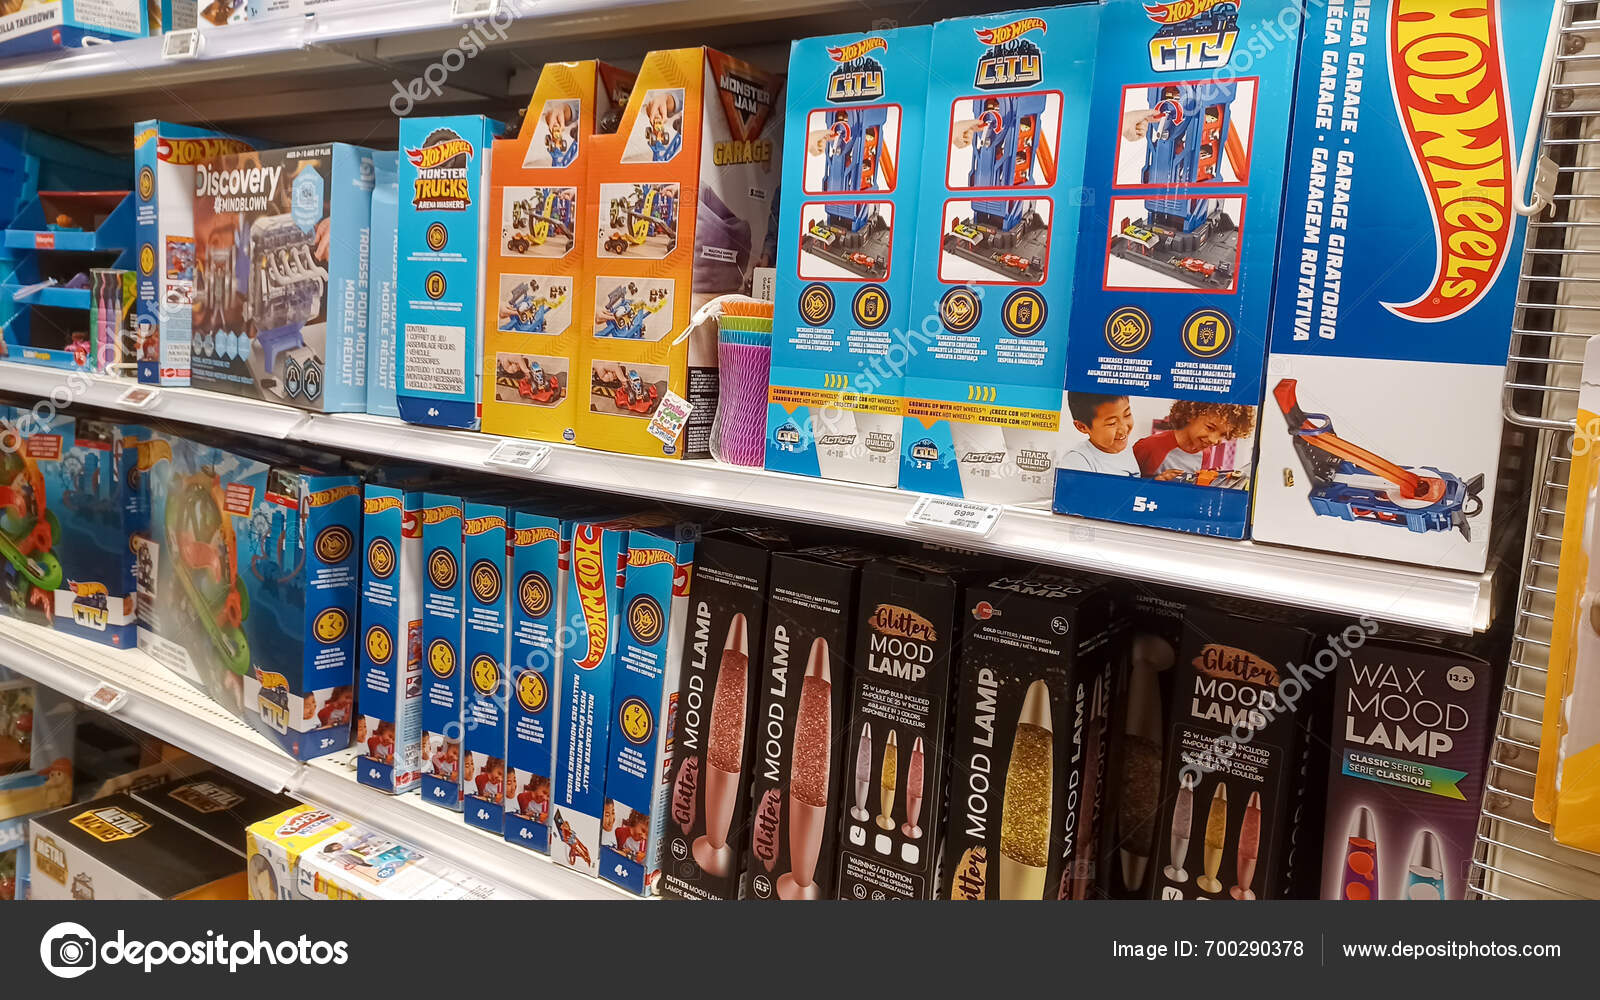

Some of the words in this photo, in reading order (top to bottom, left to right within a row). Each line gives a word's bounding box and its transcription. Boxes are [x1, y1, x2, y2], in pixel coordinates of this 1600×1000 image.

[16, 11, 56, 28] TAKEDOWN
[991, 24, 1012, 45] HOT
[1010, 17, 1046, 38] WHEELS
[1166, 2, 1193, 23] HOT
[840, 43, 860, 62] HOT
[857, 37, 887, 56] WHEELS
[1397, 0, 1491, 104] HOT
[719, 75, 770, 105] MONSTER
[734, 97, 758, 115] JAM
[1315, 50, 1339, 130] GARAGE
[1341, 52, 1365, 133] GARAGE
[422, 148, 441, 167] HOT
[439, 141, 472, 161] WHEELS
[713, 140, 772, 166] GARAGE
[197, 164, 285, 201] Discovery
[415, 179, 468, 200] TRUCKS
[418, 168, 466, 179] MONSTER
[1330, 151, 1354, 230] GARAGE
[418, 200, 437, 209] ARENA
[1303, 147, 1328, 244] GARAGEM
[1407, 88, 1505, 298] WHEELS
[358, 227, 369, 288] TROUSSE
[1293, 248, 1318, 341] ROTATIVA
[1318, 234, 1345, 340] GIRATORIO
[357, 290, 368, 328] POUR
[355, 335, 367, 387] MOTEUR
[961, 452, 1006, 464] ACTION
[1016, 457, 1051, 468] BUILDER
[1021, 450, 1049, 460] TRACK
[1132, 496, 1158, 512] 5+
[575, 535, 602, 591] HOT
[630, 550, 647, 566] HOT
[645, 550, 675, 565] WHEELS
[988, 581, 1068, 598] LAMP
[579, 584, 607, 662] WHEELS
[691, 601, 712, 670] LAMP
[876, 608, 932, 641] Glitter
[770, 625, 791, 698] LAMP
[870, 634, 934, 663] MOOD
[1202, 648, 1275, 685] Glitter
[868, 654, 926, 682] LAMP
[1349, 658, 1425, 696] WAX
[572, 674, 580, 705] RALLYE
[973, 667, 998, 748] LAMP
[1194, 675, 1276, 711] MOOD
[586, 693, 595, 726] ROLLER
[683, 674, 704, 750] MOOD
[1191, 698, 1267, 731] LAMP
[1347, 687, 1469, 732] MOOD
[568, 722, 577, 772] MONTAGNES
[584, 726, 593, 764] COASTER
[764, 702, 785, 782] MOOD
[1345, 716, 1454, 758] LAMP
[1062, 769, 1080, 858] MOOD
[1072, 682, 1085, 764] LAMP
[1349, 753, 1389, 768] CLASSIC
[1391, 760, 1424, 776] SERIES
[1349, 761, 1374, 776] SÉRIE
[1376, 769, 1432, 788] CLASSIQUE
[673, 757, 699, 827] Glitter
[966, 753, 991, 839] MOOD
[756, 790, 782, 861] Glitter
[666, 874, 689, 890] GLITTER
